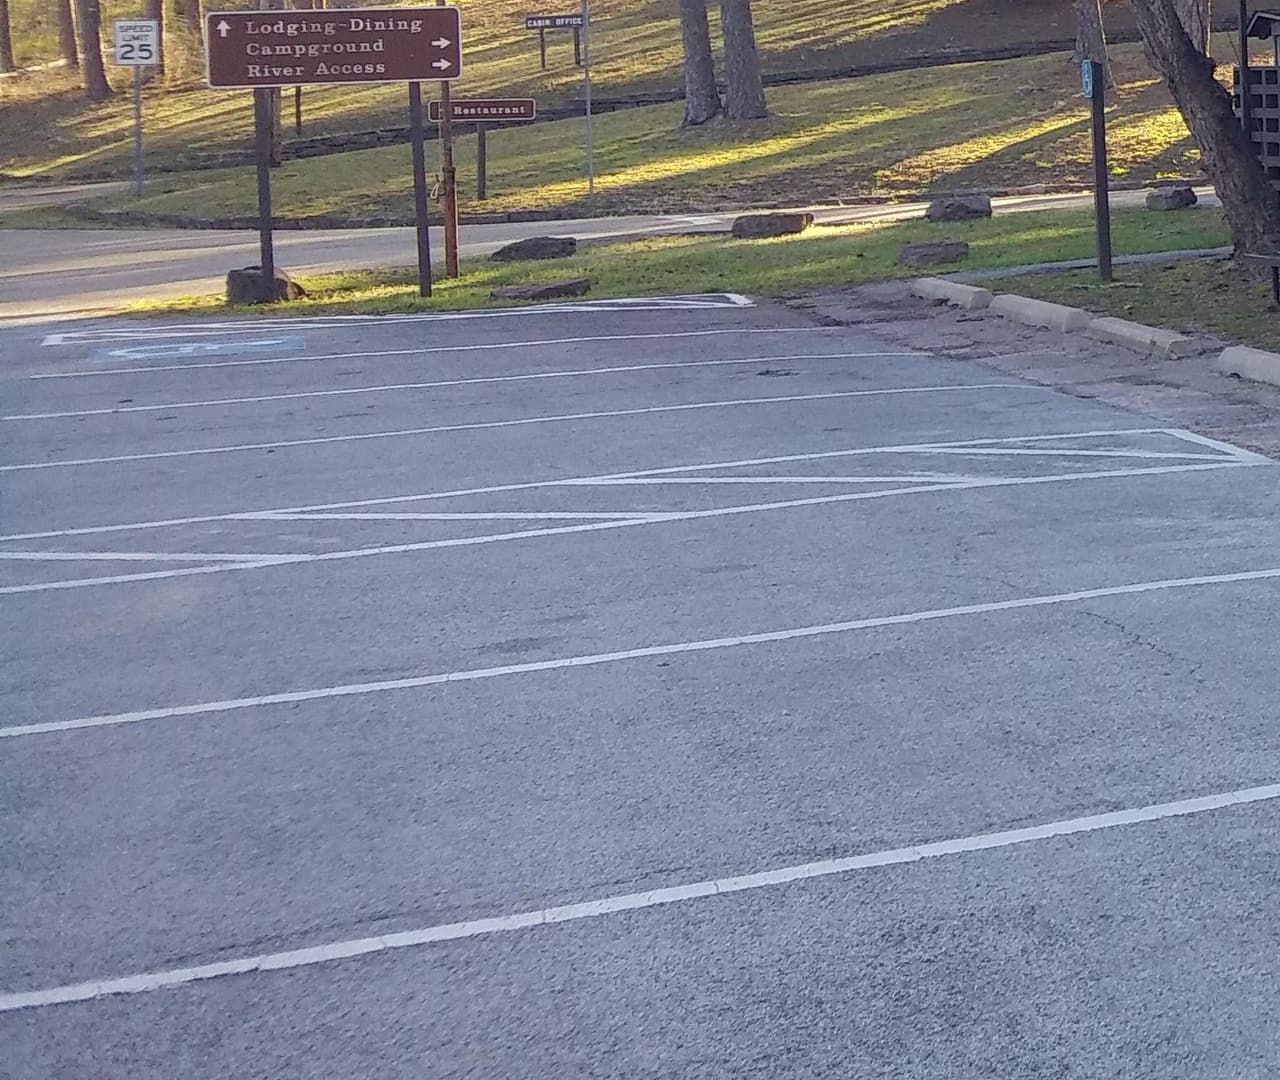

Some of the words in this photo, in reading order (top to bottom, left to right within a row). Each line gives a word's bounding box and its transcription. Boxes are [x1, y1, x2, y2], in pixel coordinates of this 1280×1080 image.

[527, 19, 551, 27] CABIN
[555, 17, 583, 26] OFFICE
[119, 25, 153, 33] SPEED
[119, 44, 153, 60] 25
[246, 38, 385, 58] Campground
[247, 64, 304, 78] River
[315, 61, 385, 76] Access
[453, 105, 526, 115] Restaurant
